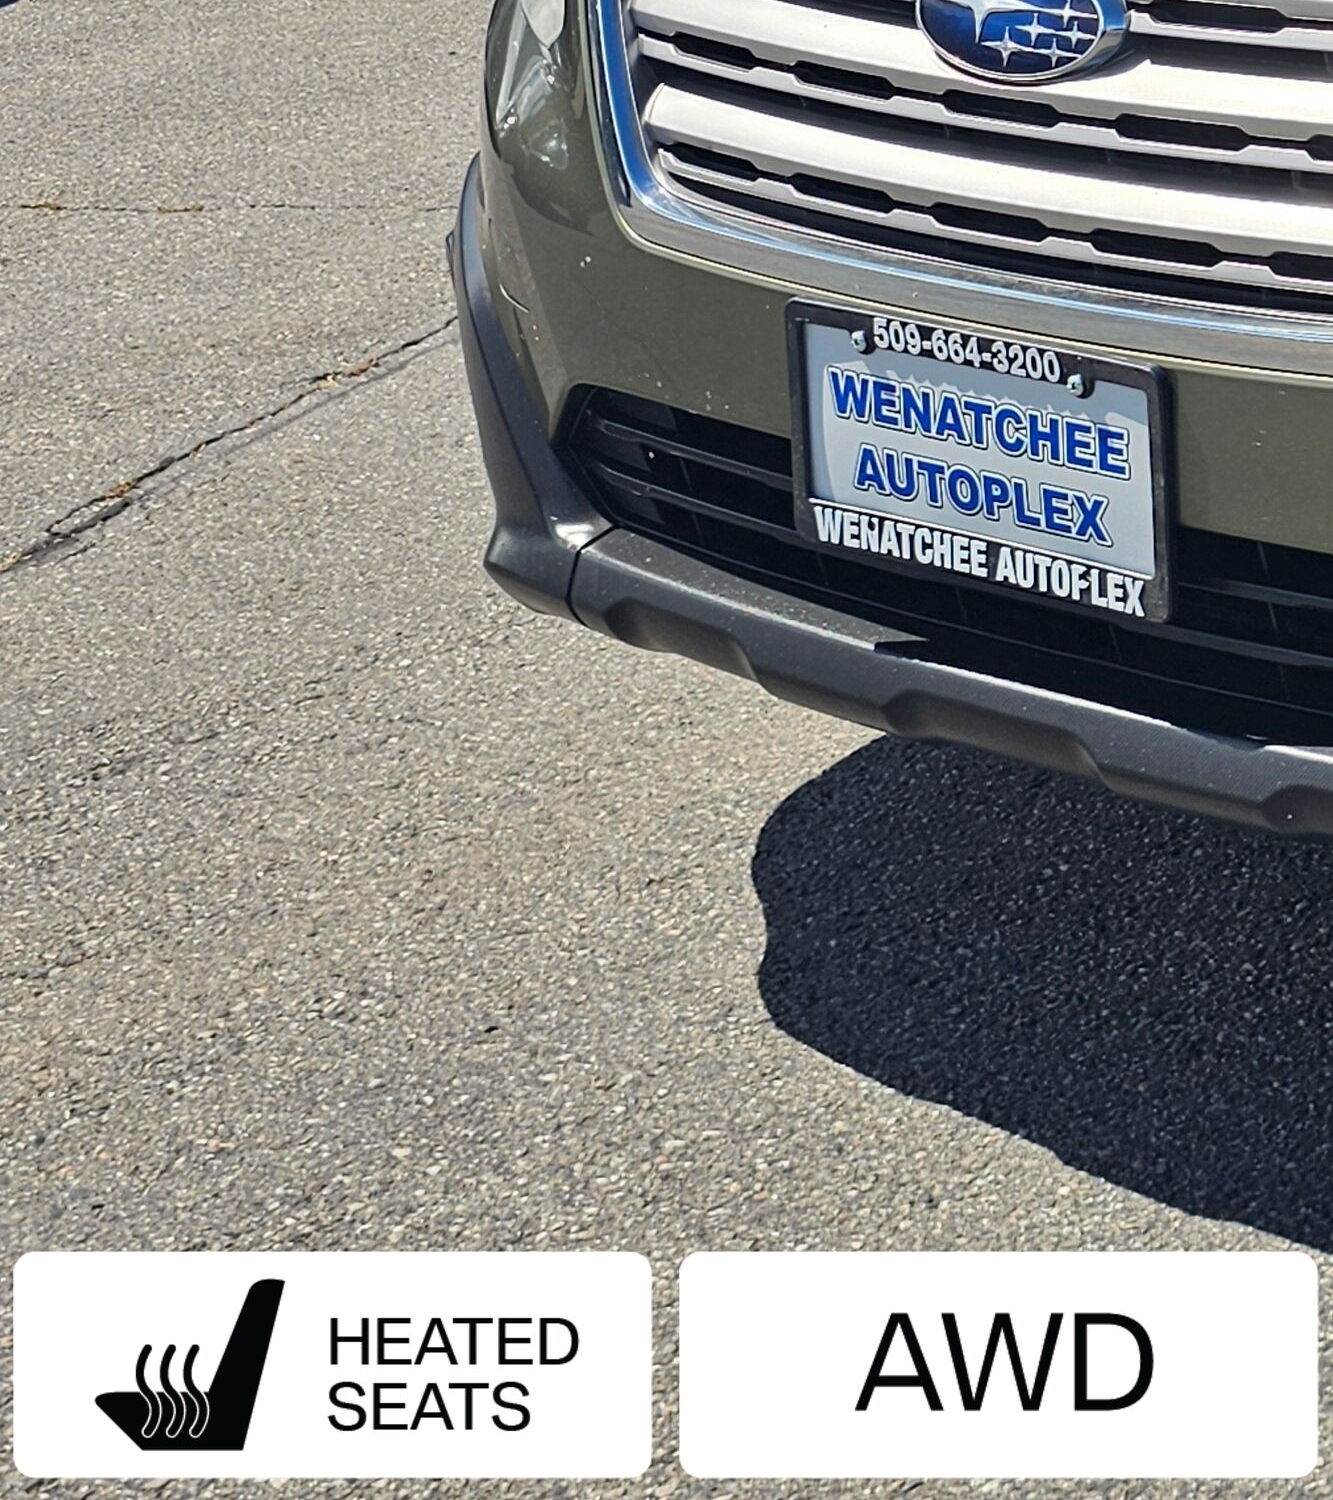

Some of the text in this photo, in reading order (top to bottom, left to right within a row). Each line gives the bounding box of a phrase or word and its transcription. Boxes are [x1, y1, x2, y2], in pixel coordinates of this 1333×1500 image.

[872, 317, 1061, 384] 509-664-3200
[827, 366, 1131, 481] WENATCHEE
[855, 444, 1114, 547] AUTOPLEX
[813, 505, 1146, 618] WENATCHEE AUTOPLEX
